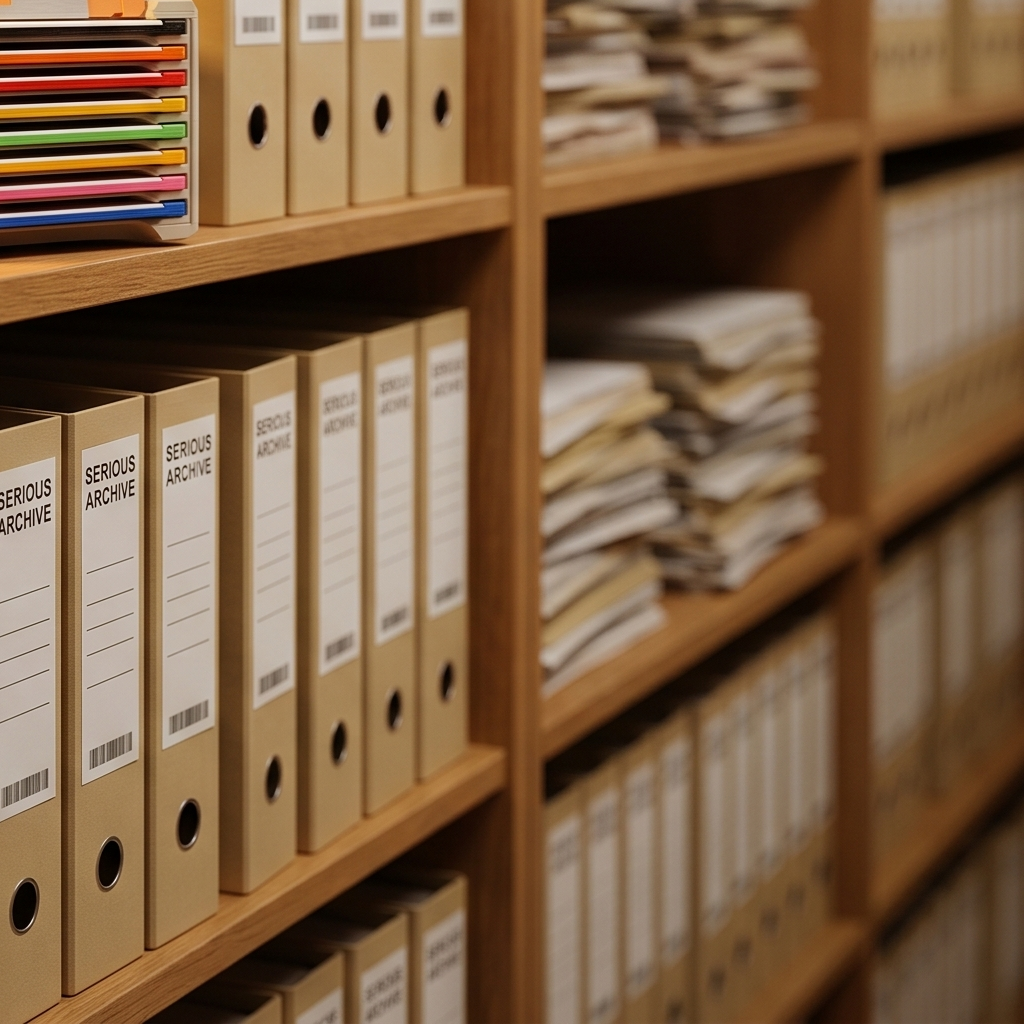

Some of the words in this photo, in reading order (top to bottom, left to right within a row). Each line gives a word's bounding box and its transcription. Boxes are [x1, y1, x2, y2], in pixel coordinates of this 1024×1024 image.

[256, 411, 292, 437] SERIOUS
[166, 434, 212, 462] SERIOUS
[256, 433, 292, 459] ARCHIVE
[85, 454, 136, 485] SERIOUS
[166, 457, 212, 487] ARCHIVE
[85, 479, 136, 511] ARCHIVE
